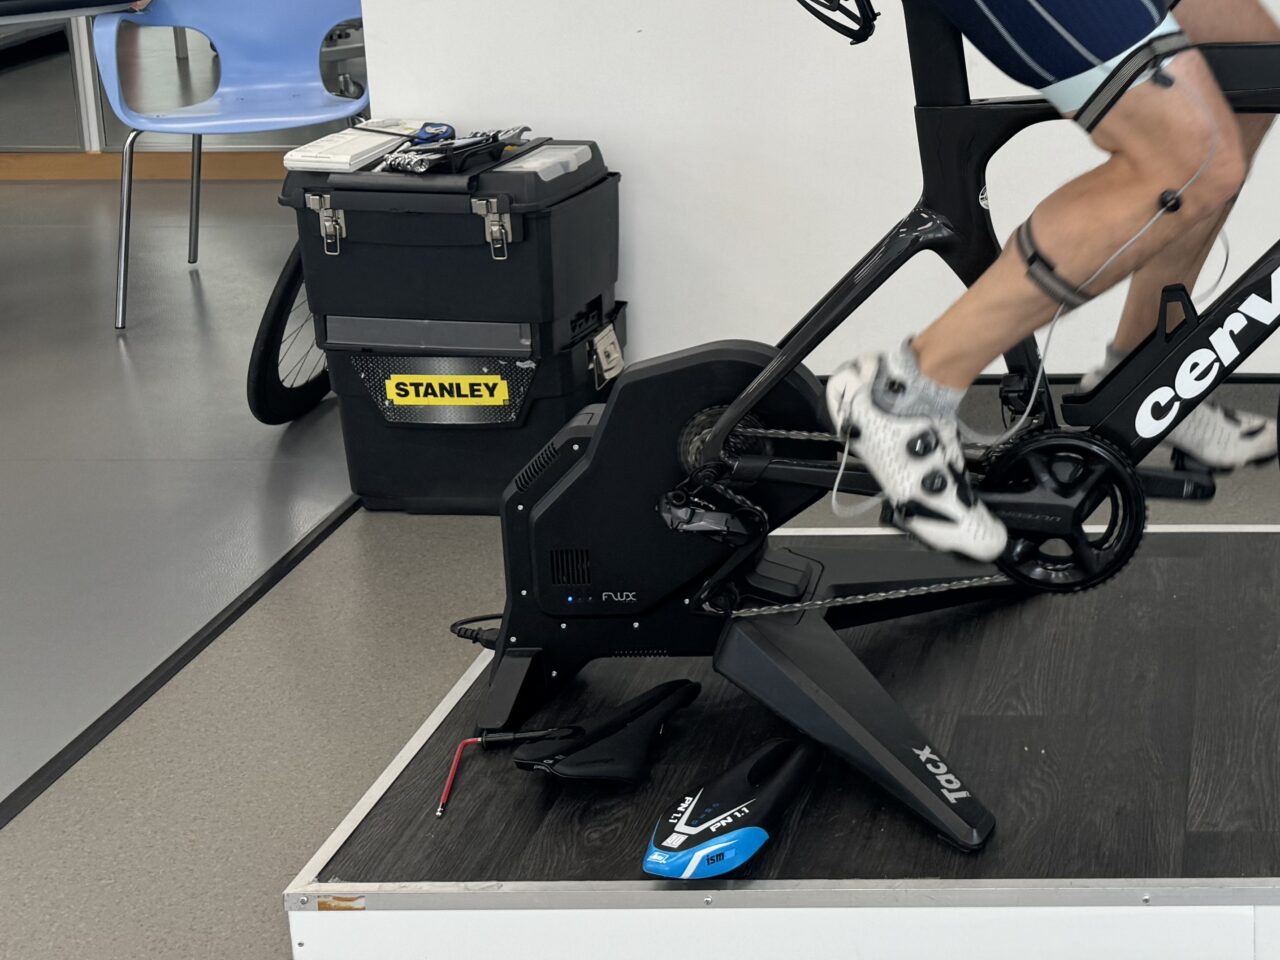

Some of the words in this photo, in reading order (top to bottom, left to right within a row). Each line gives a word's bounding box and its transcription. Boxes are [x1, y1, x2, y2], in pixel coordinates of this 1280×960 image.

[394, 381, 499, 398] STANLEY
[602, 592, 637, 601] FLUX
[911, 744, 972, 804] Tacx
[681, 796, 693, 812] PN
[709, 816, 734, 833] PN
[733, 806, 750, 818] 1.1
[705, 852, 725, 866] ism
